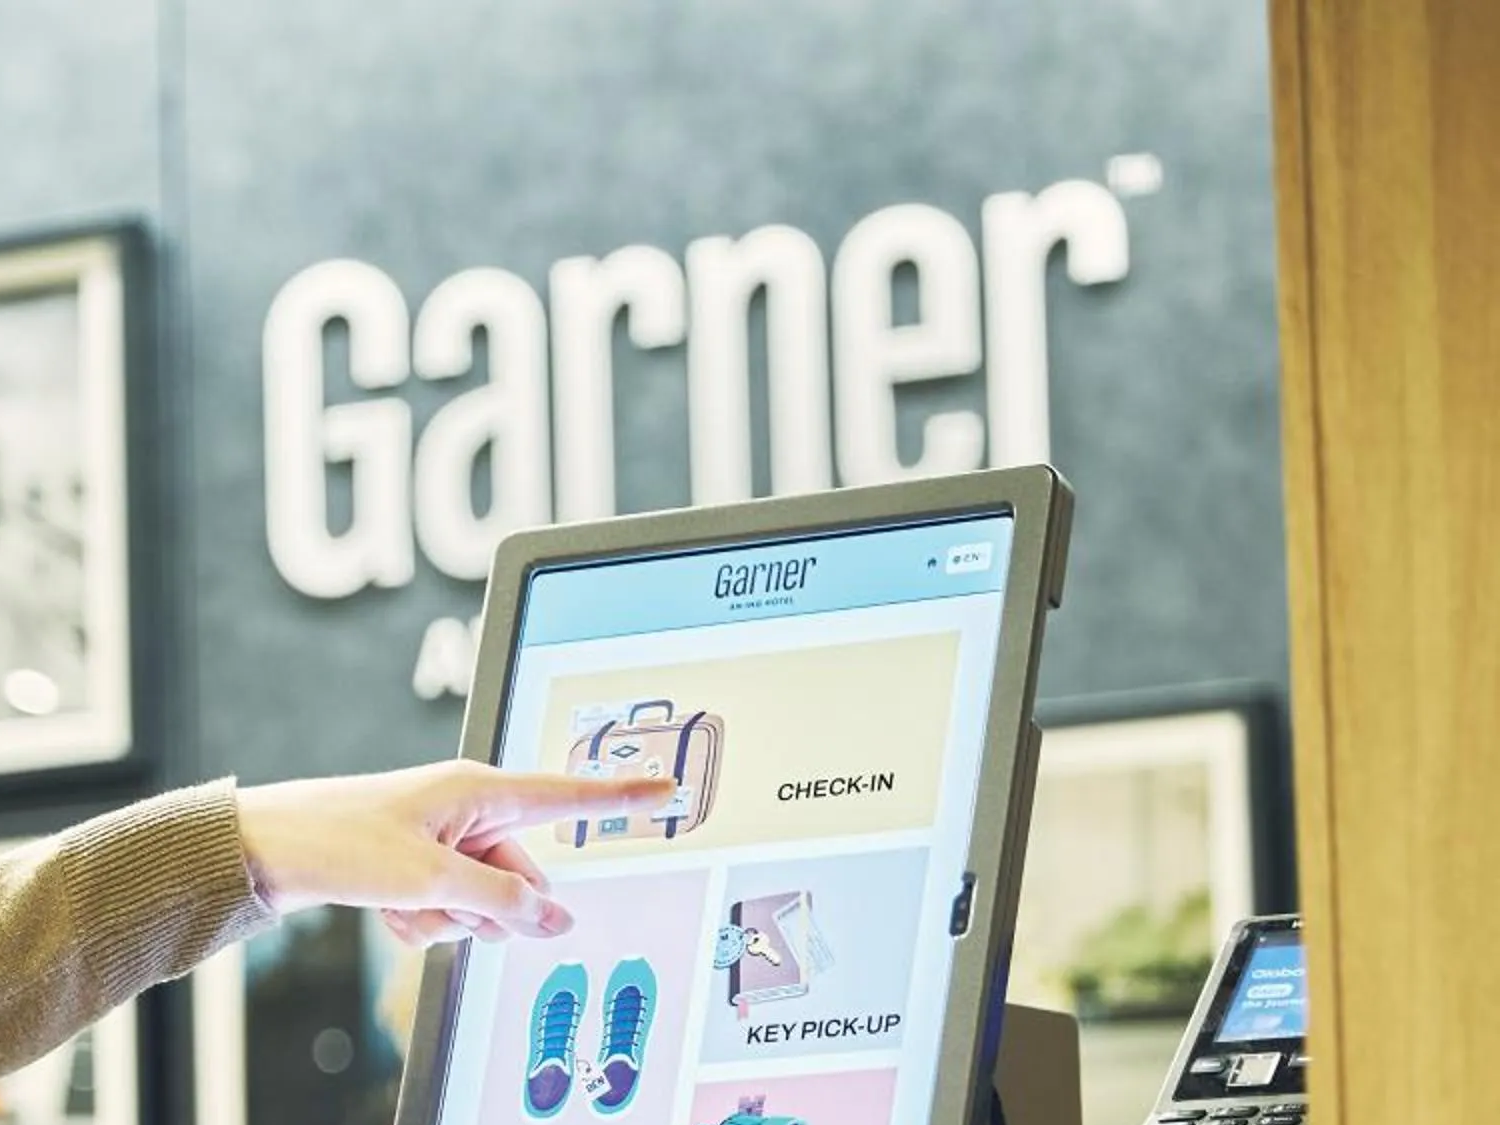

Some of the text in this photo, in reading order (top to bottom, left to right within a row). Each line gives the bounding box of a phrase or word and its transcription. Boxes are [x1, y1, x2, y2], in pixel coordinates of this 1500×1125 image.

[714, 556, 817, 599] Garner
[777, 772, 895, 802] CHECK-IN
[747, 1013, 901, 1045] KEY PICK-UP
